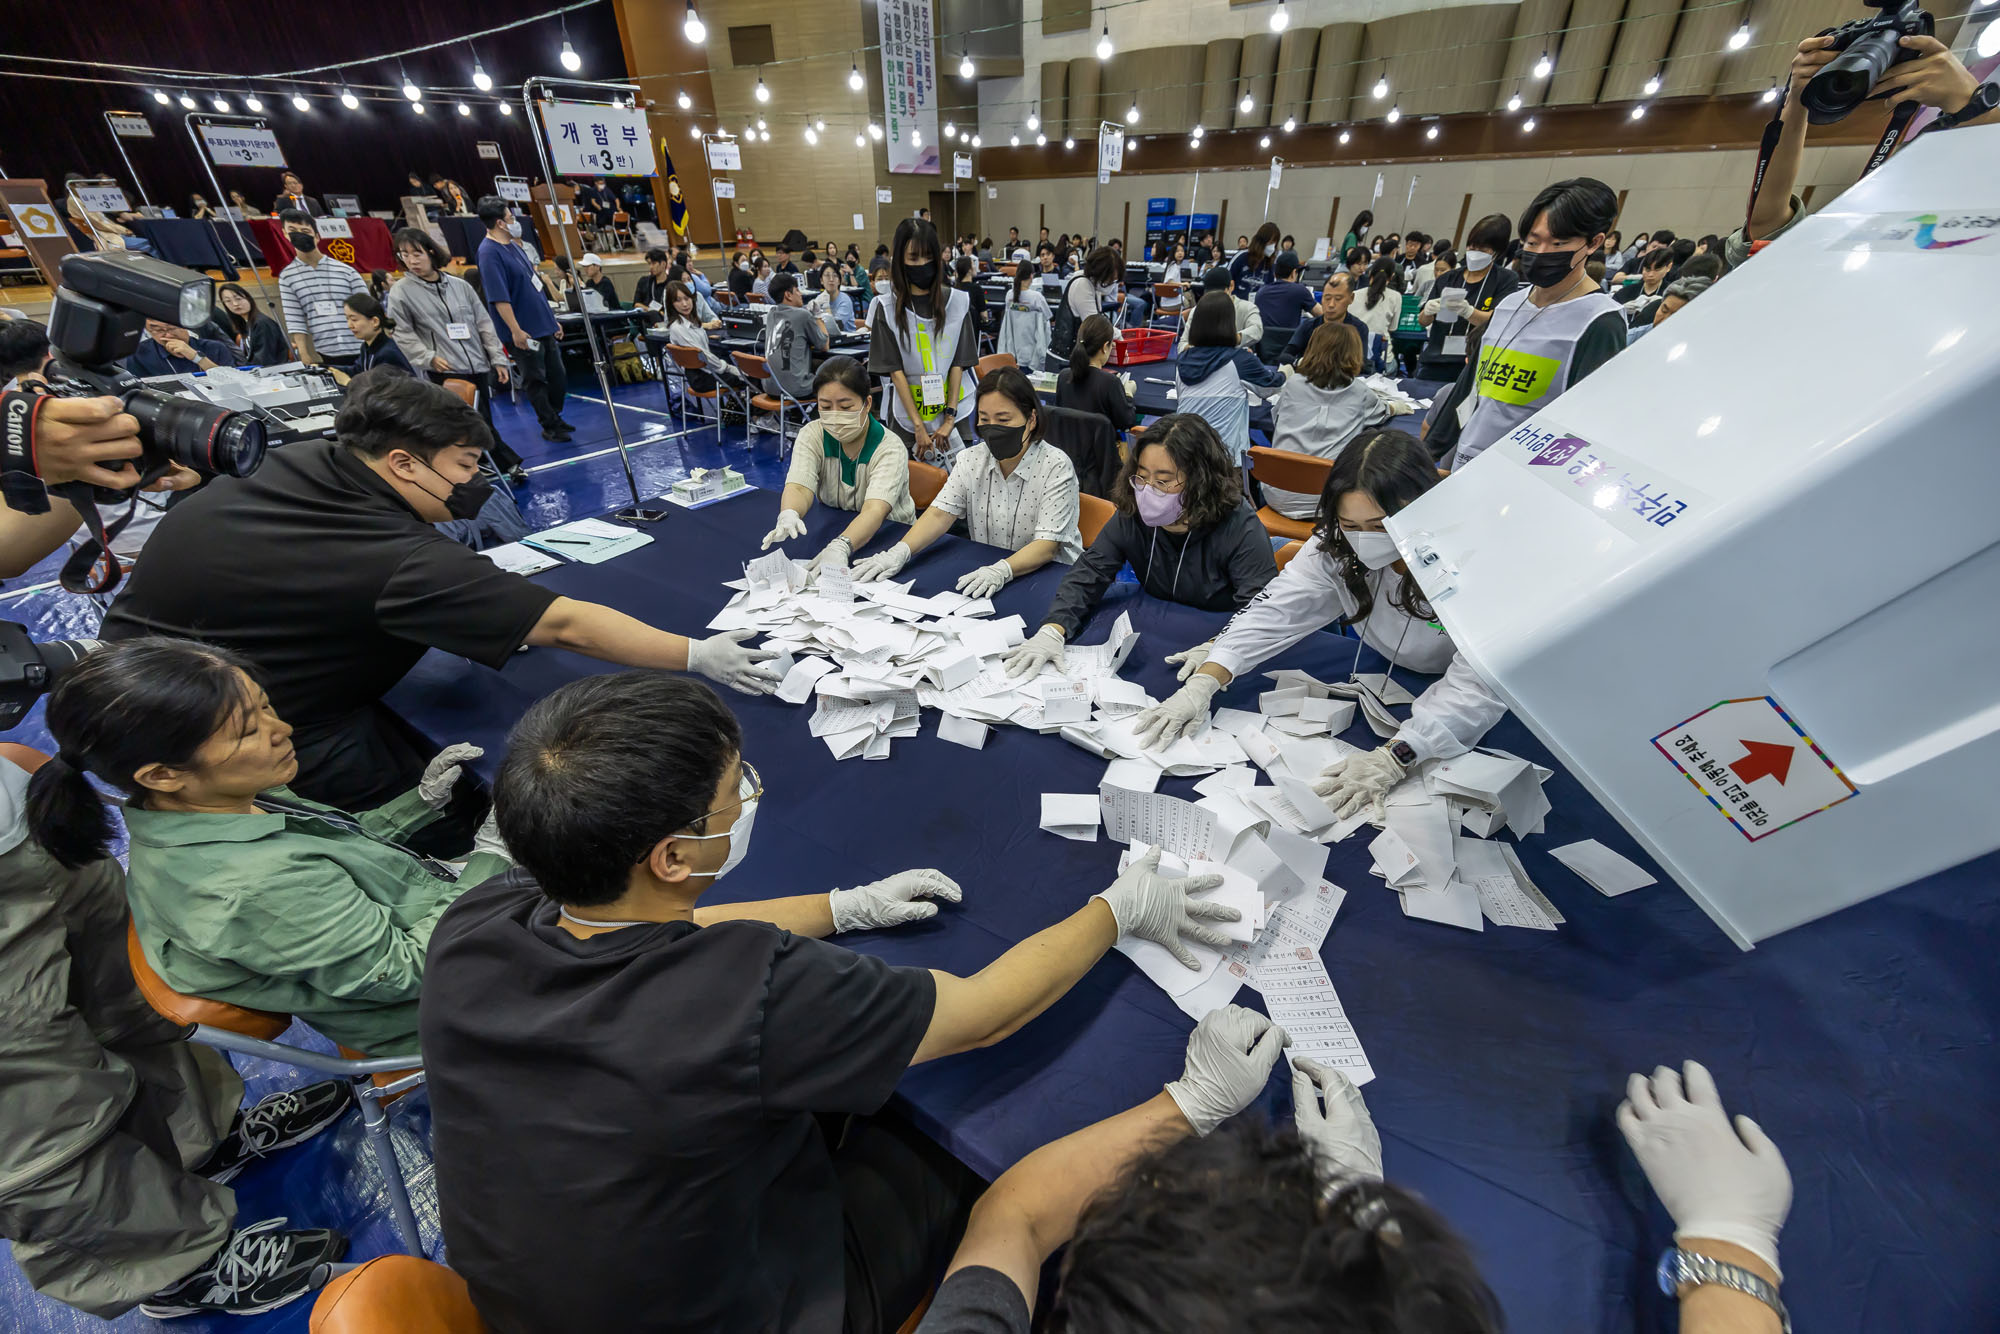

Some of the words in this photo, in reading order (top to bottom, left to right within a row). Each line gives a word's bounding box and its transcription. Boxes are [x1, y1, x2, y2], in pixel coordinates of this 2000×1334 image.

[921, 7, 931, 62] 주인되는
[897, 61, 905, 87] 복지
[906, 62, 914, 88] 교육
[915, 50, 923, 77] 경제
[888, 58, 897, 114] 하나되는
[925, 65, 932, 91] 중구
[899, 91, 907, 117] 중구
[908, 92, 916, 118] 중구
[916, 81, 924, 106] 중구
[891, 118, 899, 143] 중구
[1880, 129, 1899, 154] EOS
[7, 399, 28, 456] Canon
[1675, 734, 1707, 763] 주세요
[1698, 759, 1730, 787] 이동해
[1722, 783, 1750, 804] 잡고
[1739, 800, 1769, 827] 이곳을
